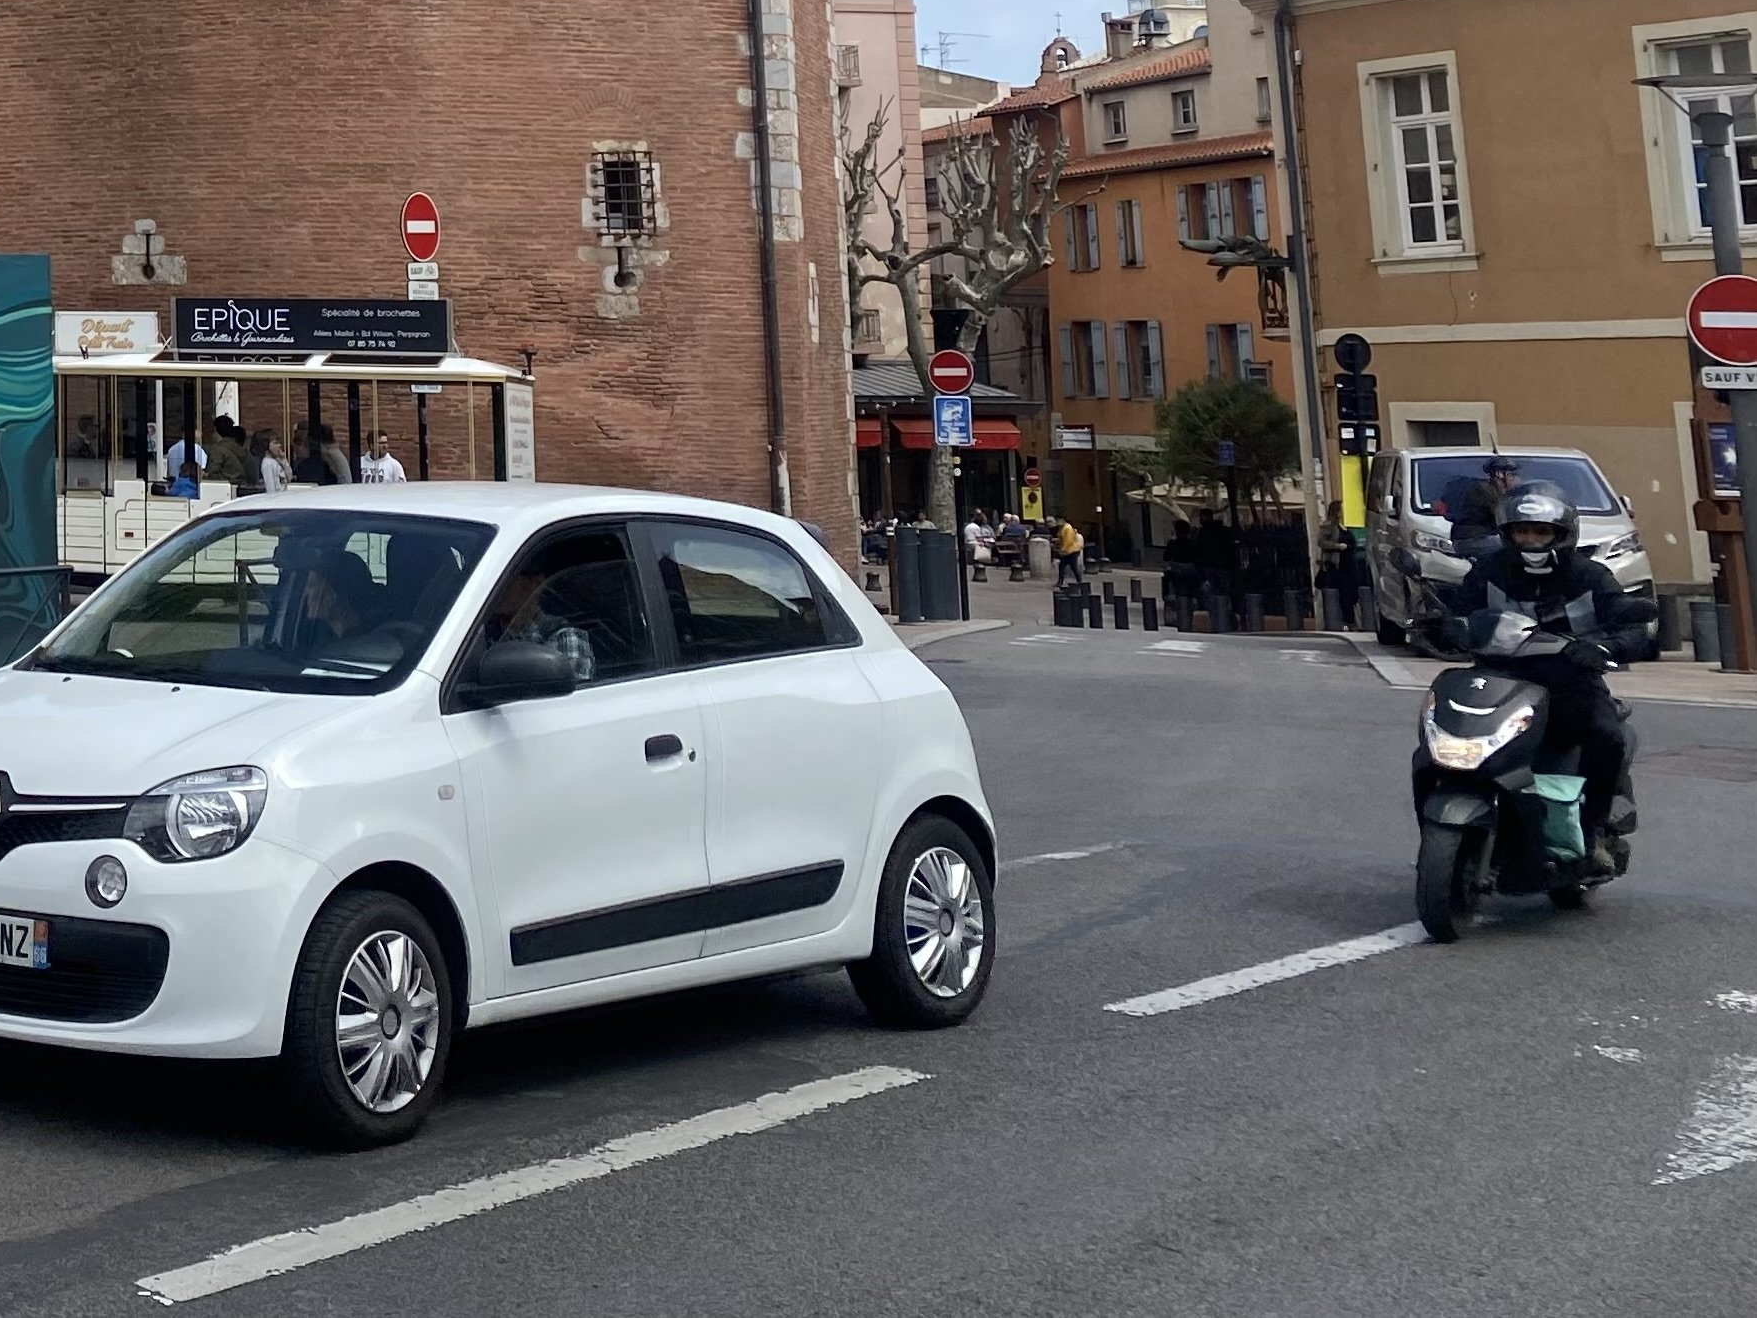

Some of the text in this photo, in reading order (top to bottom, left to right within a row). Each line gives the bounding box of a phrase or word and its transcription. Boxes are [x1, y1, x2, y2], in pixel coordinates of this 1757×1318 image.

[194, 303, 291, 333] EPIQUE
[321, 308, 421, 318] Spécialité de brochettes
[81, 318, 134, 334] Départ
[397, 330, 431, 338] Perpignan
[104, 335, 134, 349] Train
[367, 340, 377, 348] 75
[1704, 372, 1757, 383] SAUF V
